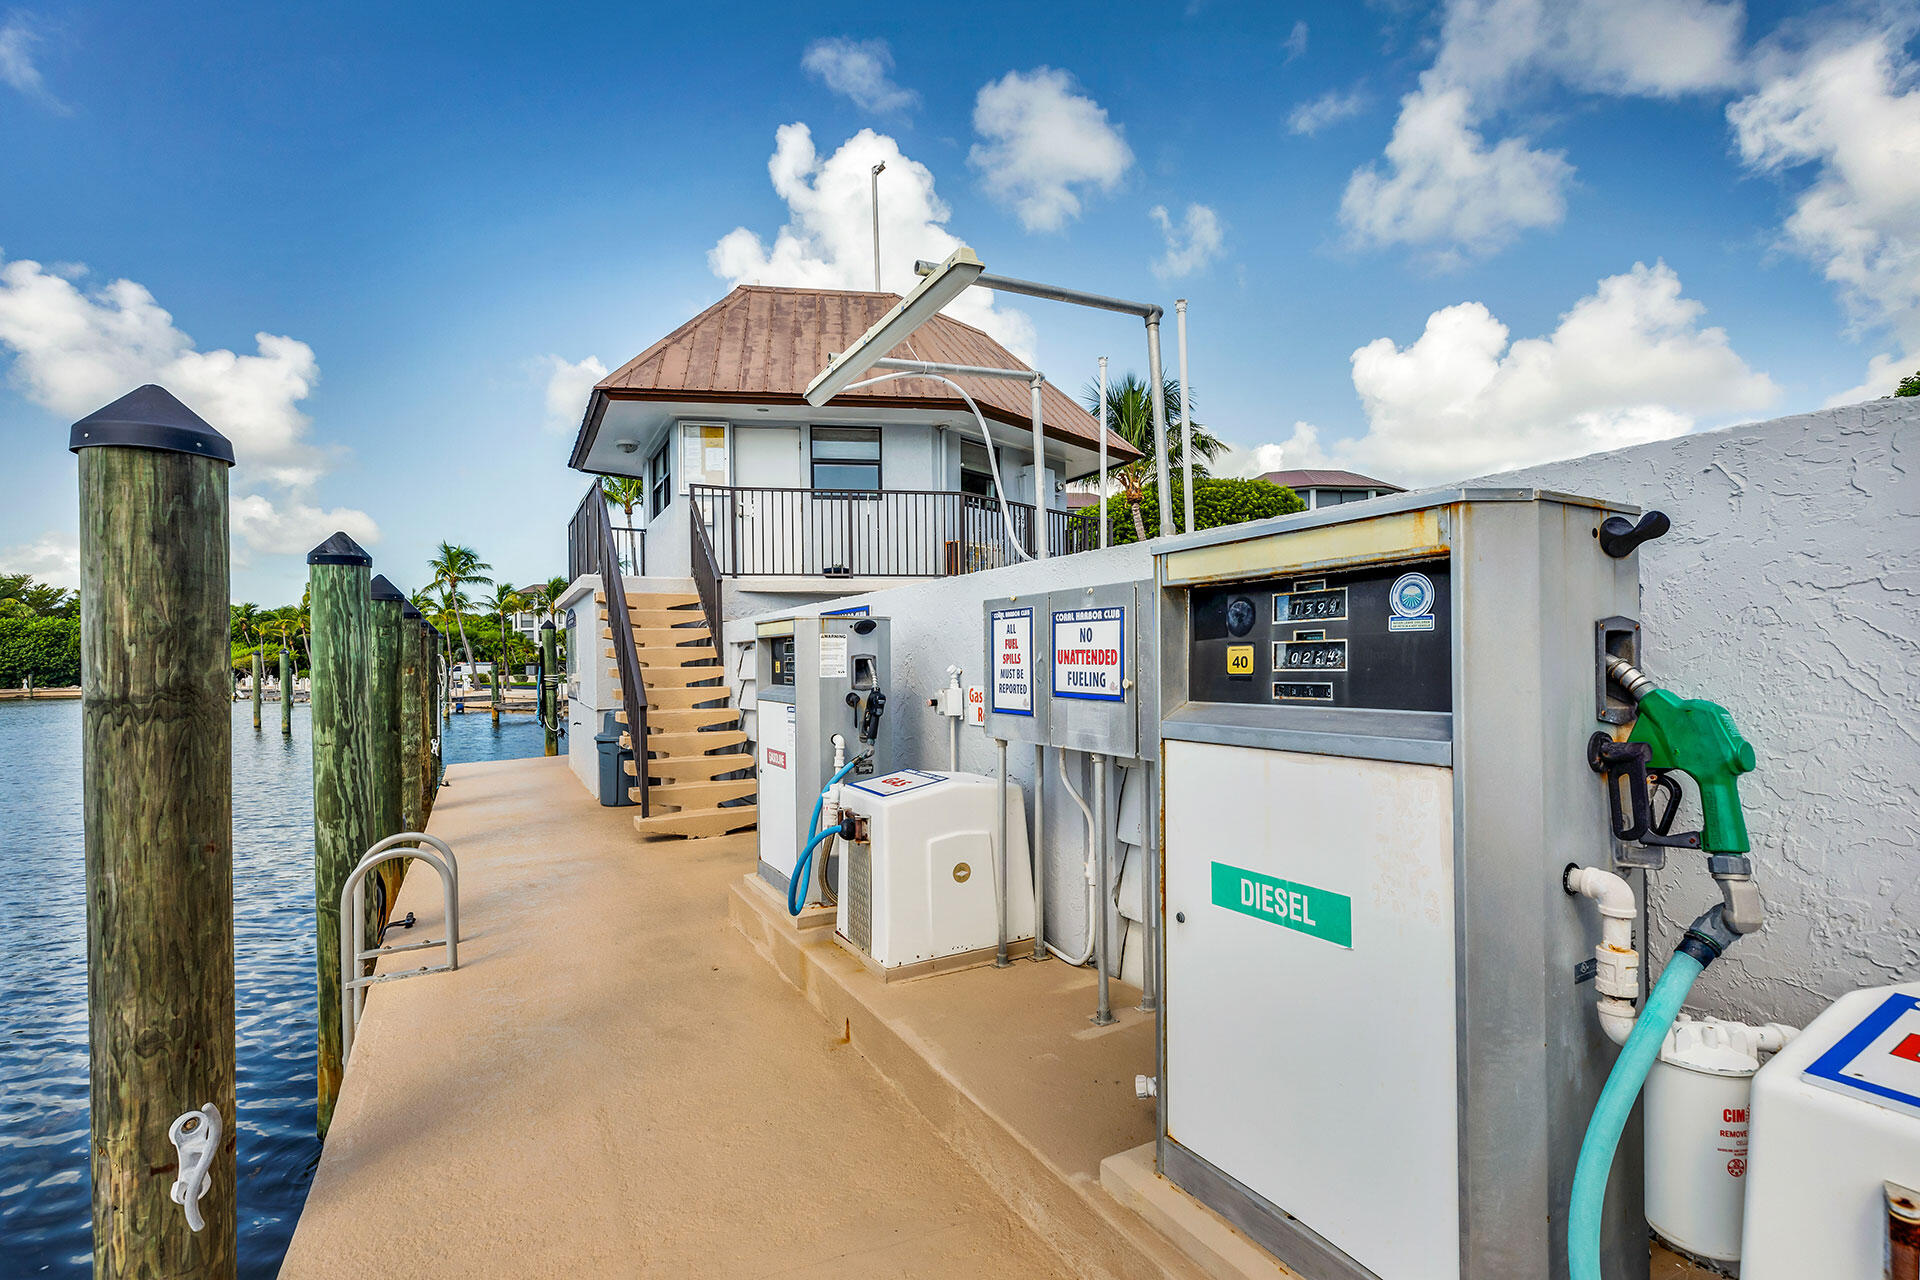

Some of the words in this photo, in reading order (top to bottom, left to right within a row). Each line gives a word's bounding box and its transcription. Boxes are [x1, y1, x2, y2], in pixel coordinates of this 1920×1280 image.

[1055, 611, 1075, 622] CORAL
[1075, 610, 1103, 621] HARBOR
[1103, 608, 1120, 619] CLUB
[1006, 623, 1016, 634] ALL
[1079, 627, 1093, 643] NO
[1004, 638, 1018, 650] FUEL
[1002, 653, 1021, 664] SPILLS
[1057, 648, 1118, 666] UNATTENDED
[1232, 655, 1248, 669] 40
[1000, 668, 1015, 679] MUST
[1016, 668, 1024, 679] BE
[1067, 671, 1106, 688] FUELING
[969, 687, 983, 703] Gas
[998, 683, 1028, 695] REPORTED
[977, 707, 985, 722] R
[881, 777, 912, 787] GAS
[1240, 878, 1316, 926] DIESEL
[1723, 1108, 1745, 1123] CIM
